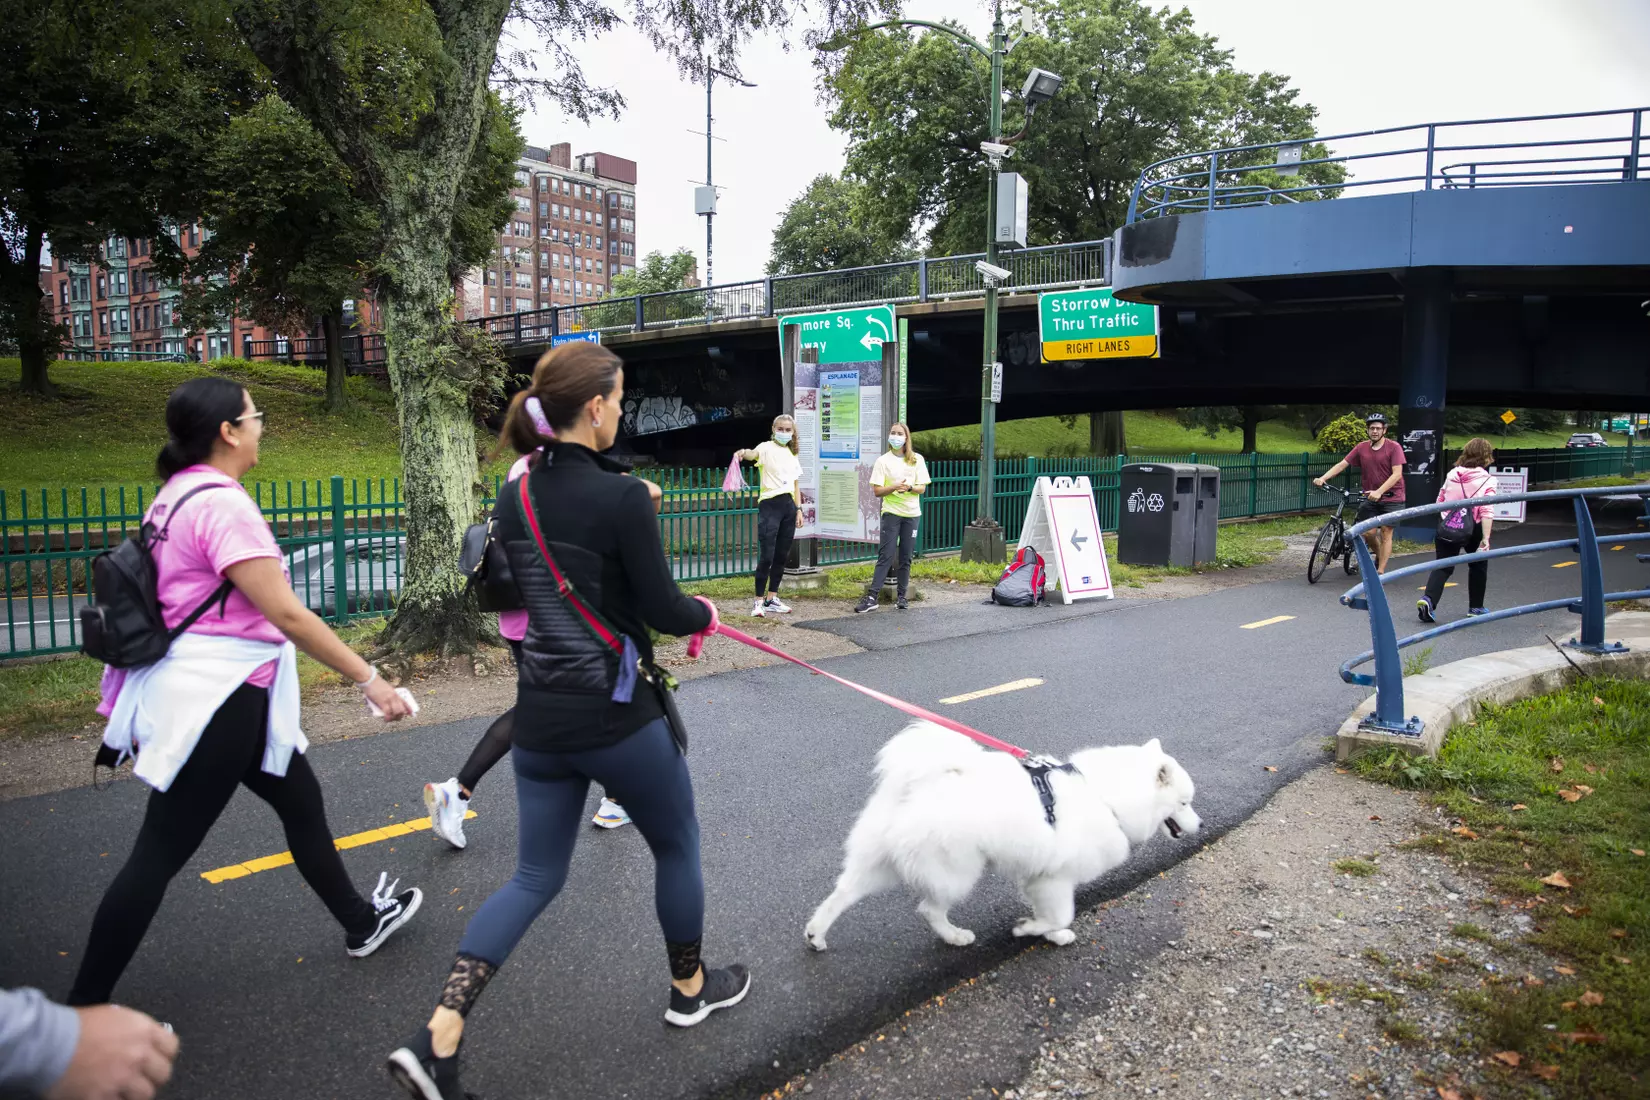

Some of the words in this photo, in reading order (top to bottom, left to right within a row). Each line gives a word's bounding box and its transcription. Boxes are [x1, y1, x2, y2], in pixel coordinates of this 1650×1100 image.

[1051, 298, 1111, 313] Storrow
[836, 316, 854, 330] Sq.
[1052, 318, 1085, 331] Thru
[1089, 312, 1139, 329] Traffic
[1066, 342, 1094, 354] RIGHT
[1098, 340, 1131, 353] LANES
[827, 372, 858, 380] ESPLANADE
